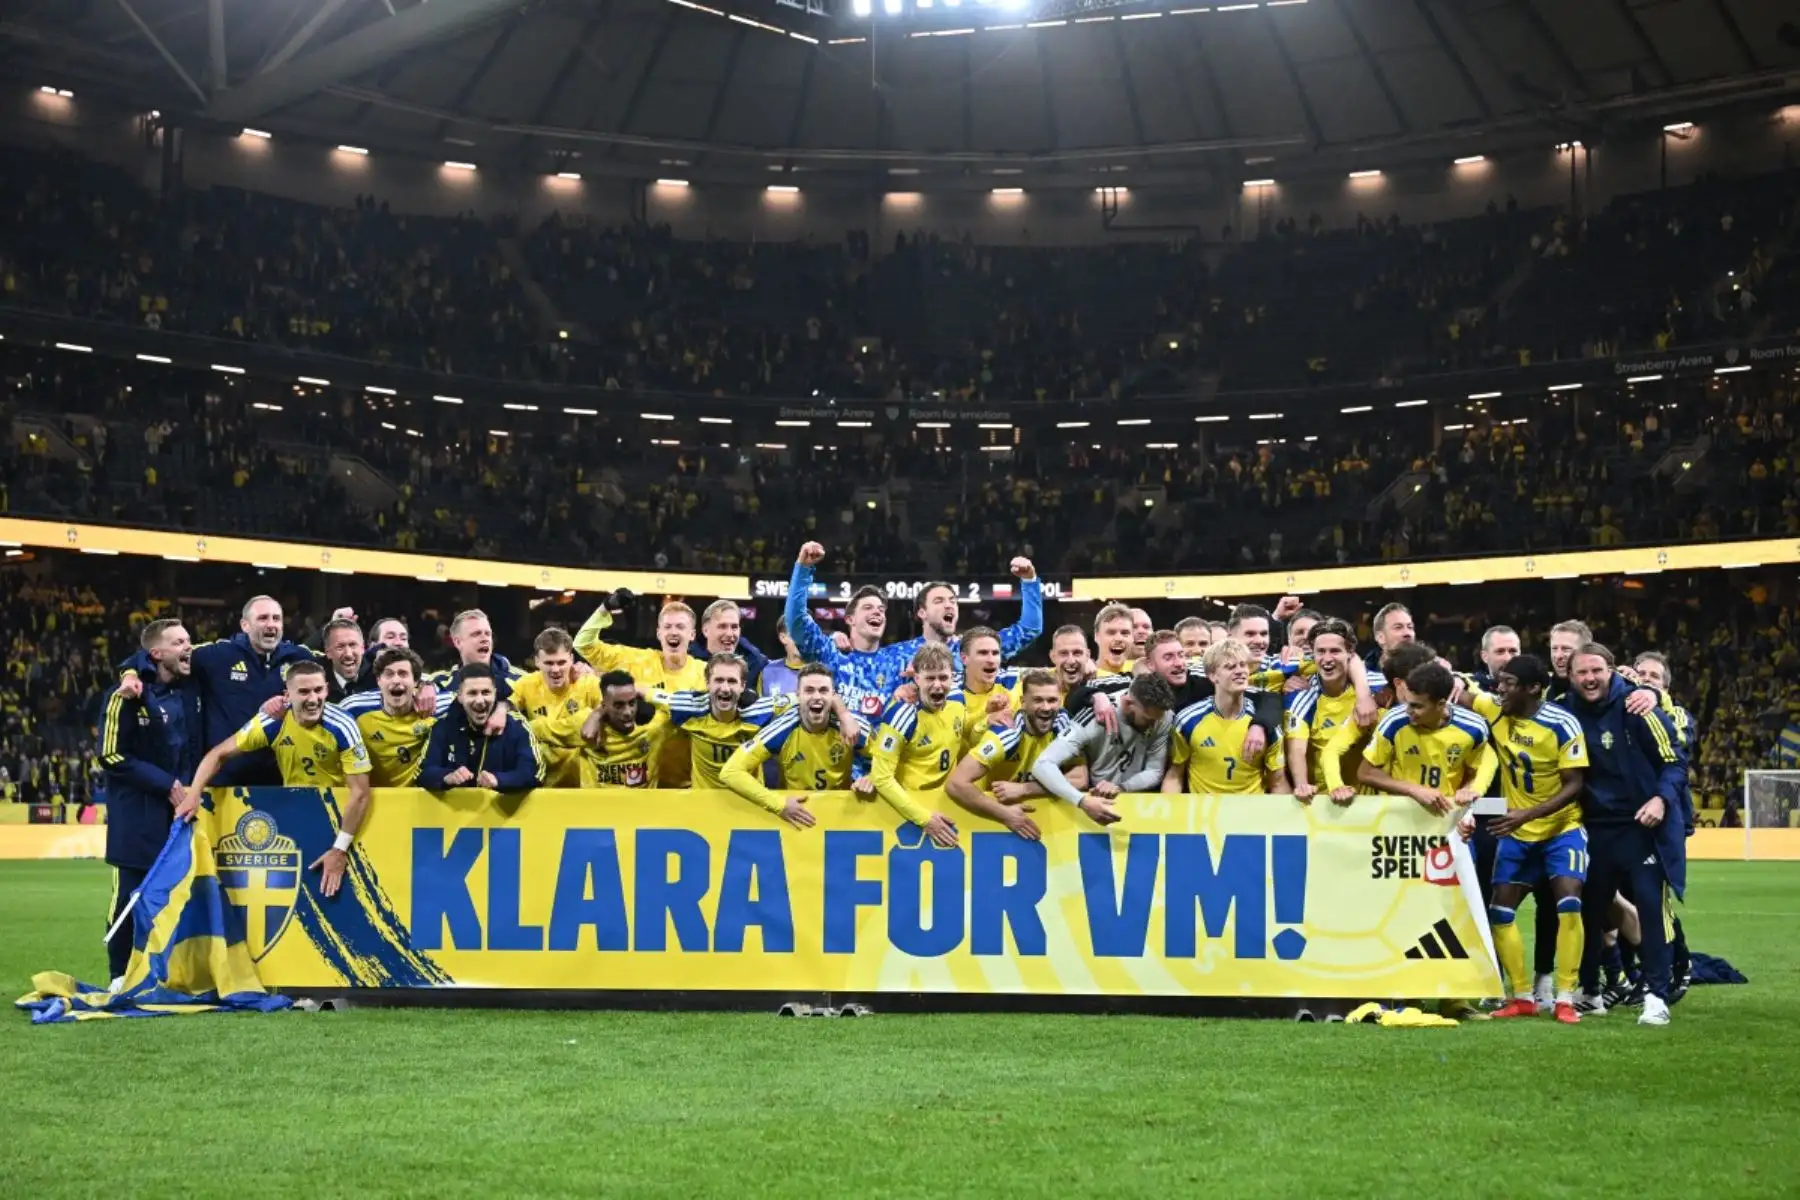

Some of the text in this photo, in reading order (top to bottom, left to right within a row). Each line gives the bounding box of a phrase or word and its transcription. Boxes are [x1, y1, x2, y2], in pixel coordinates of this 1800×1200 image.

[1750, 344, 1800, 360] Room fo
[1615, 355, 1713, 374] Strawberry Arena
[779, 406, 875, 419] Strawberry Arena
[909, 408, 1011, 420] Room for emotions
[756, 580, 789, 597] SWE
[840, 581, 852, 598] 3
[886, 581, 931, 599] 90:0
[968, 582, 980, 599] 2
[302, 756, 316, 776] 2
[939, 749, 951, 772] 8
[1223, 757, 1237, 780] 7
[815, 769, 827, 790] 5
[1420, 763, 1441, 788] 18
[225, 854, 289, 866] SVERIGE
[1371, 857, 1421, 879] SPEL
[1569, 848, 1585, 874] 11
[411, 821, 1308, 961] KLARA FÖR VM!
